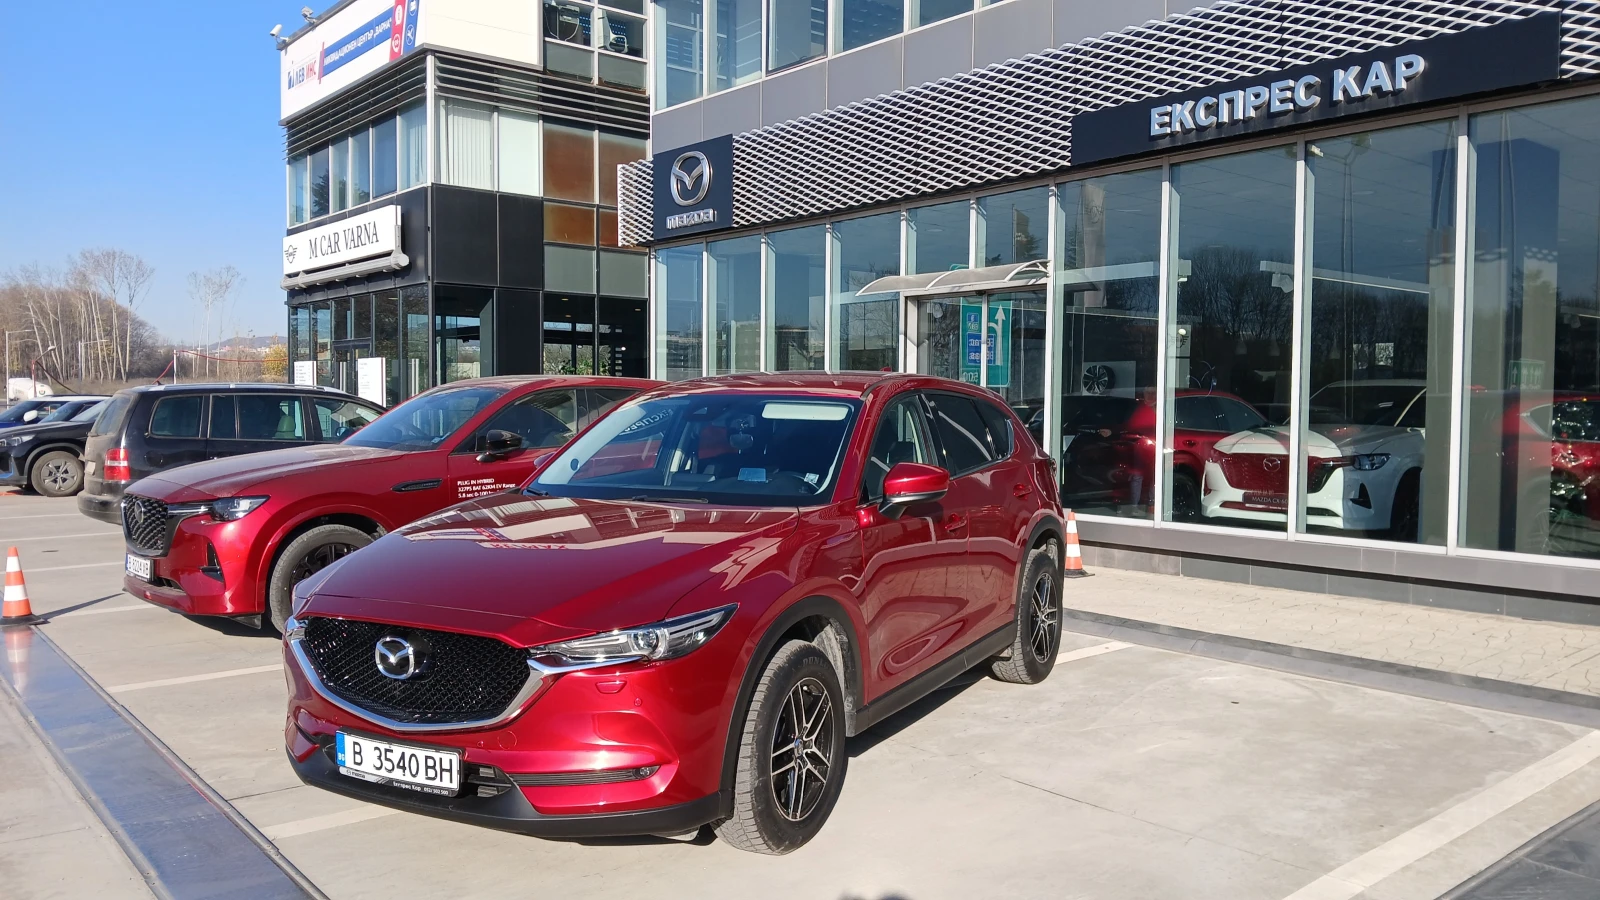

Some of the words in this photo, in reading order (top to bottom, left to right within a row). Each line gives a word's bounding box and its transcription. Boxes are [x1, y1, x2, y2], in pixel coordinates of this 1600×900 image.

[306, 60, 316, 80] ИНС
[1150, 75, 1321, 136] ЕКСПРЕС
[1333, 54, 1425, 102] КАР
[309, 237, 318, 259] M
[320, 232, 341, 256] CAR
[343, 220, 379, 251] VARNA
[802, 656, 831, 671] DUNL
[353, 741, 363, 766] B
[373, 746, 419, 778] 3540
[425, 755, 453, 784] BH
